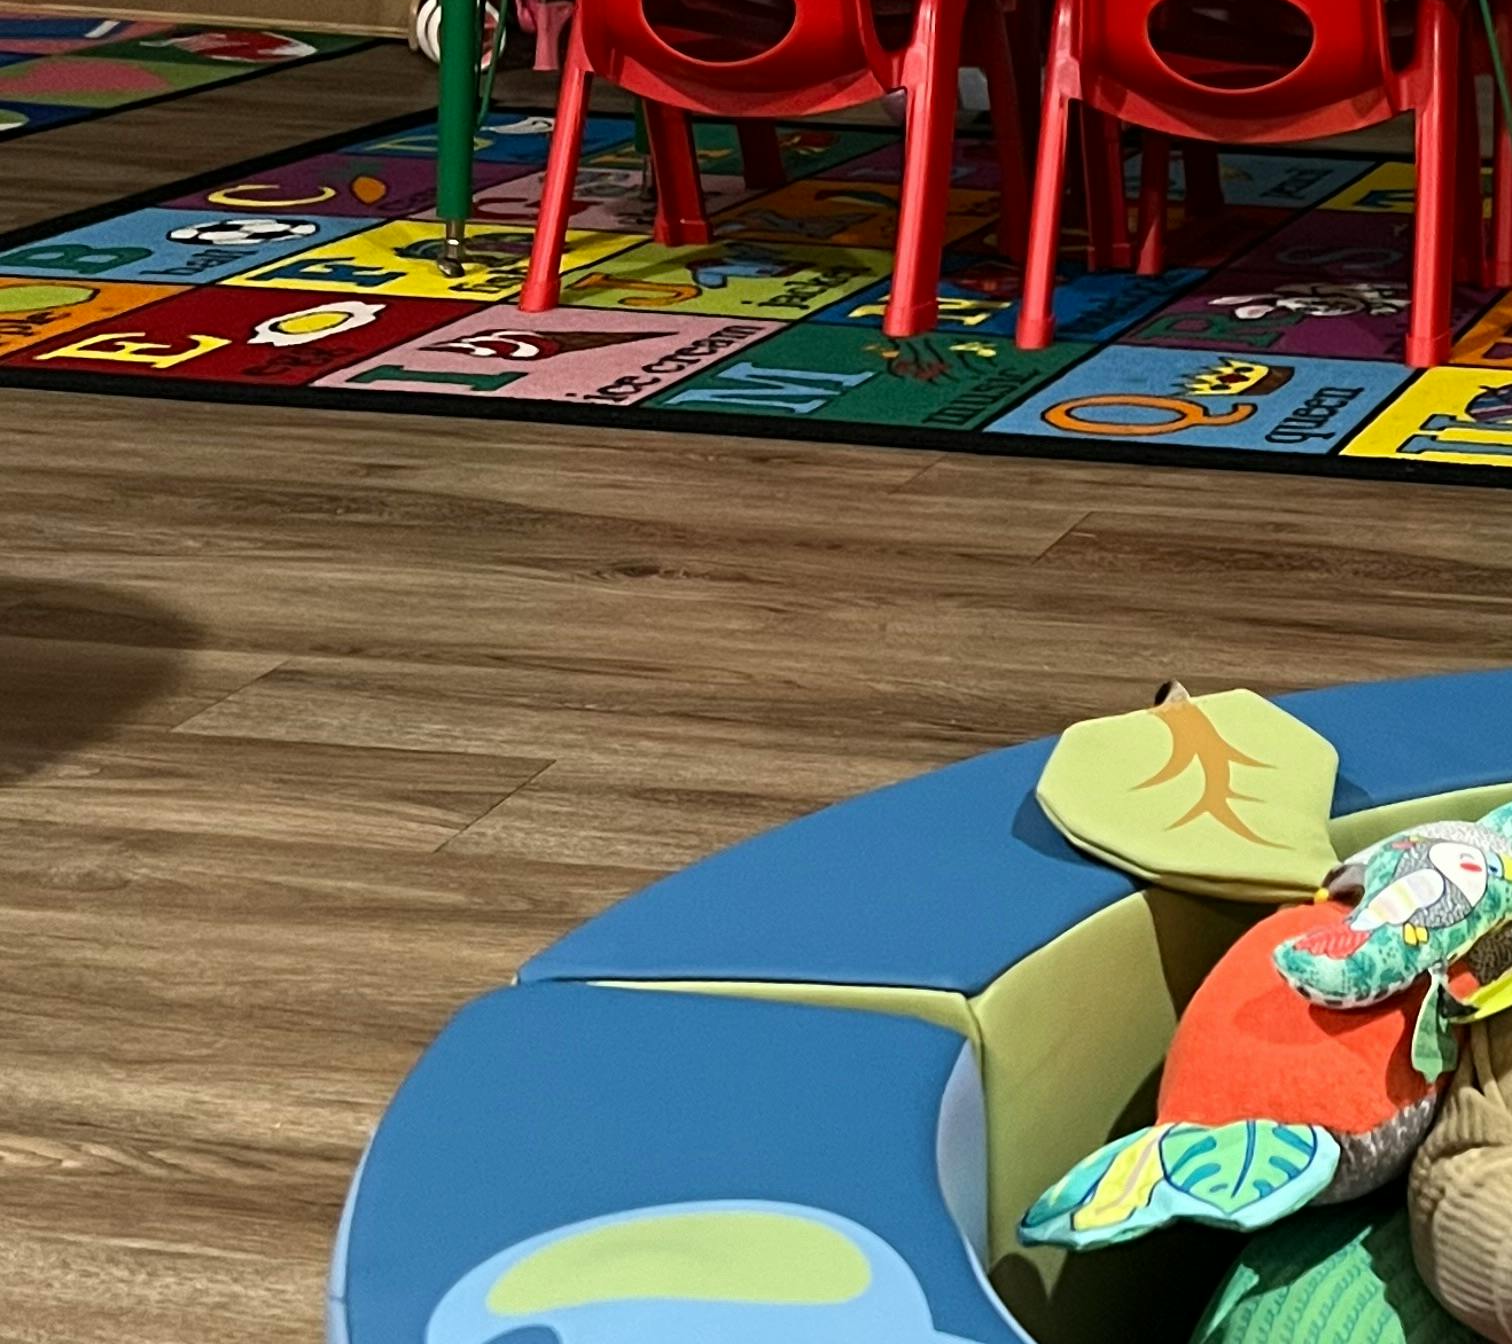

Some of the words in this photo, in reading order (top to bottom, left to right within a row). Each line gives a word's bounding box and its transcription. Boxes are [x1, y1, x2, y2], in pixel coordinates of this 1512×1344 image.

[207, 183, 337, 209] C
[0, 243, 153, 277] B
[249, 257, 407, 289] F
[565, 271, 704, 307] J
[33, 331, 234, 370] E
[565, 375, 661, 402] ice
[640, 324, 767, 375] cream
[663, 361, 880, 415] M
[923, 368, 1040, 425] music
[1040, 393, 1258, 437] Q
[1264, 385, 1365, 446] queen
